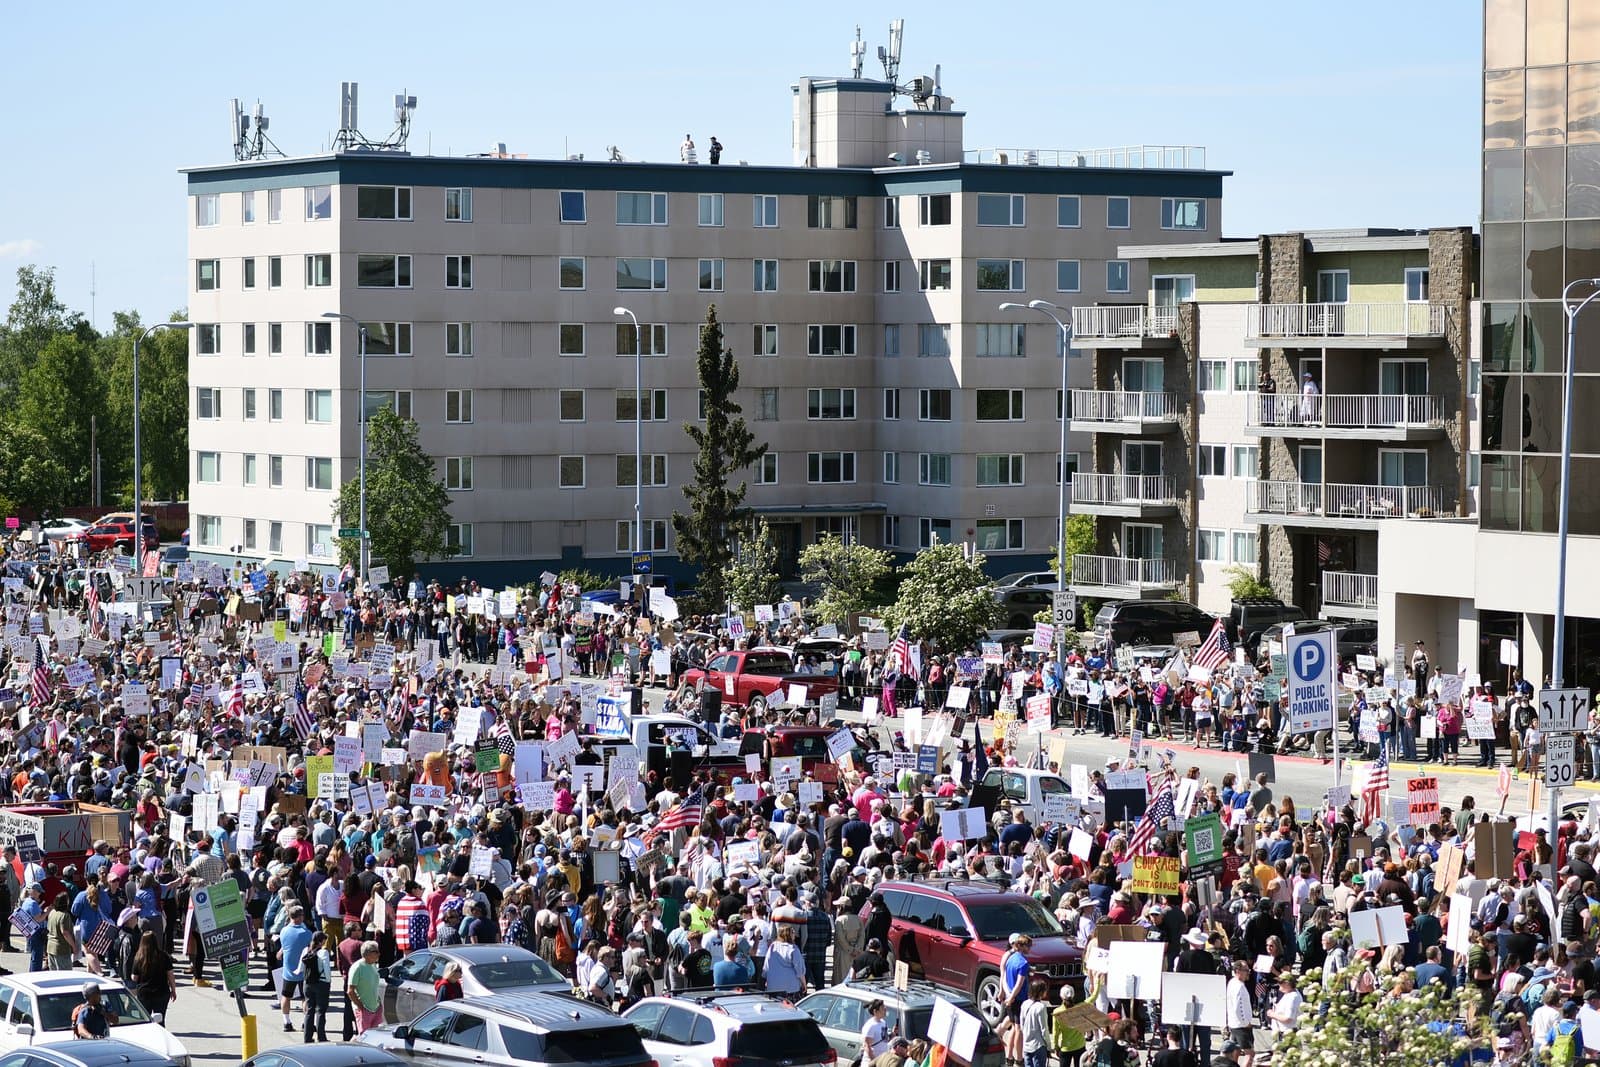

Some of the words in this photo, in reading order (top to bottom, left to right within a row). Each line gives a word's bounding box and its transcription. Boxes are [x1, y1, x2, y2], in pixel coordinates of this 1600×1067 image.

[1056, 609, 1073, 621] 30
[730, 623, 743, 634] NO
[1118, 649, 1132, 658] EXIT
[1119, 658, 1133, 667] ONLY
[1301, 645, 1319, 677] P
[1295, 684, 1325, 700] PUBLIC
[1292, 698, 1329, 716] PARKING
[1548, 740, 1572, 749] SPEED
[1551, 751, 1569, 760] LIMIT
[1550, 764, 1571, 782] 30
[1410, 779, 1436, 791] SOME
[1134, 855, 1179, 872] COURAGE
[1150, 870, 1160, 880] IS
[1132, 879, 1177, 890] CONTAGIOUS
[205, 929, 235, 947] 10957
